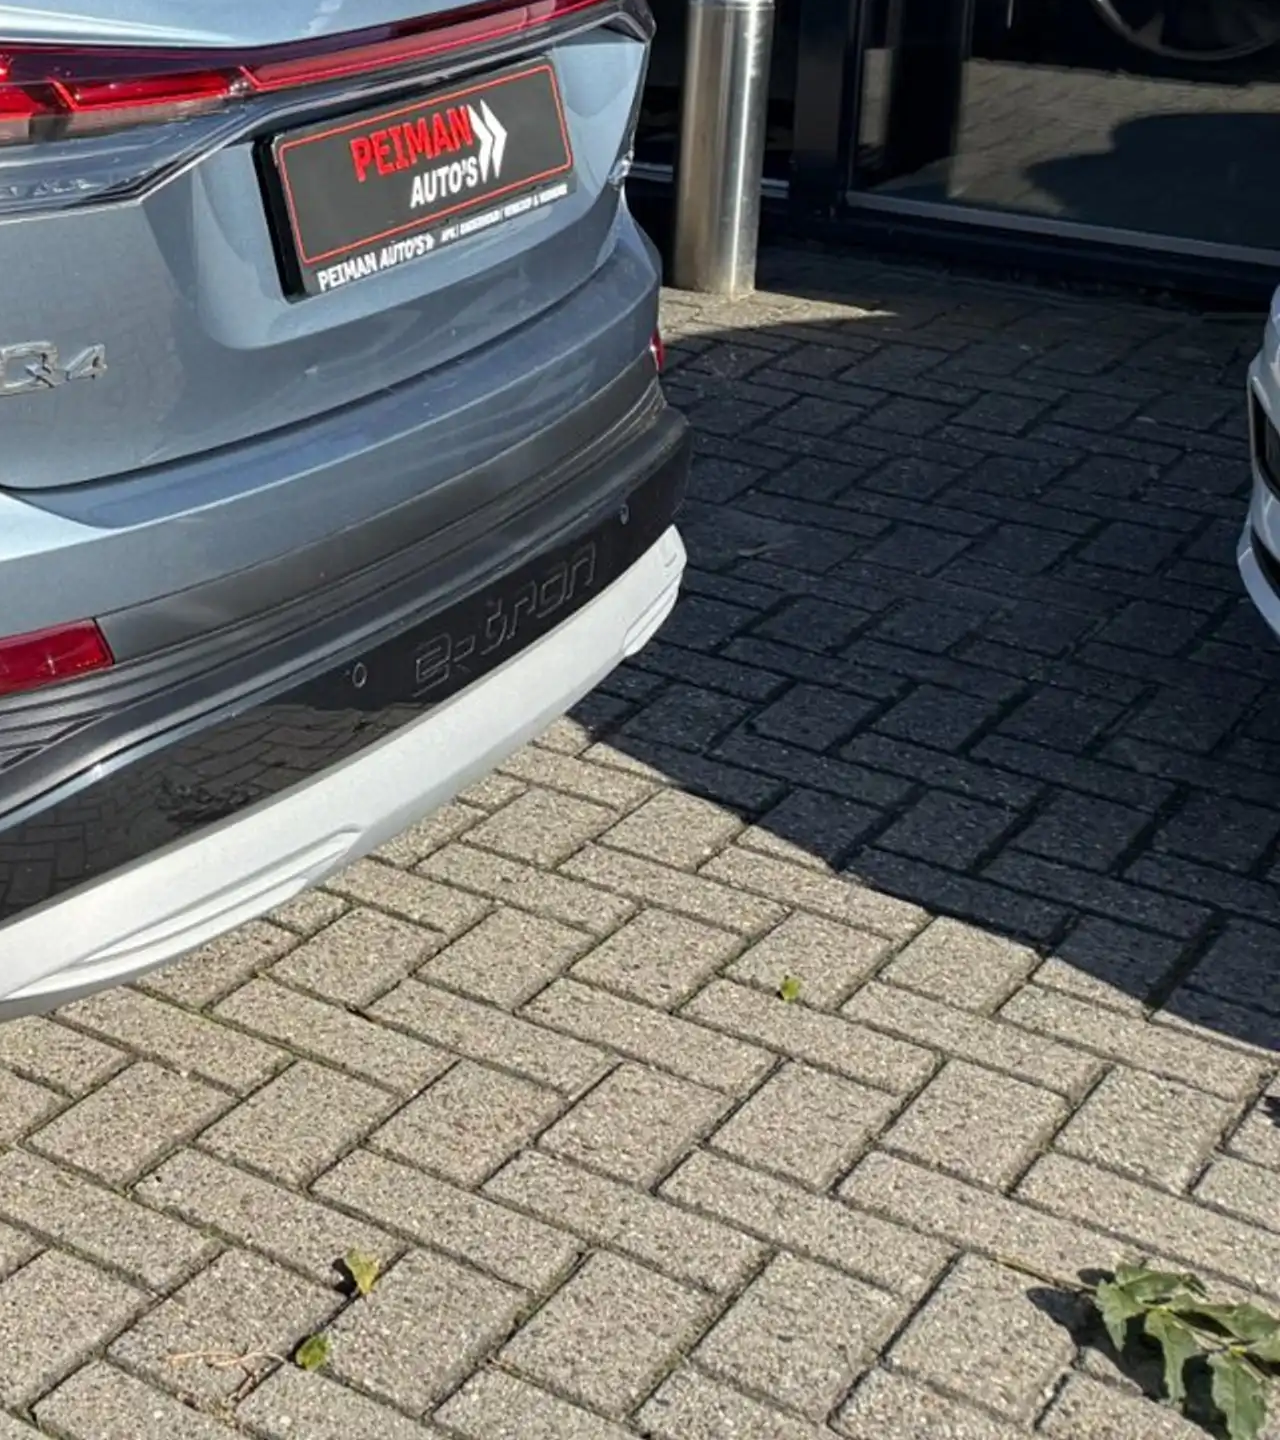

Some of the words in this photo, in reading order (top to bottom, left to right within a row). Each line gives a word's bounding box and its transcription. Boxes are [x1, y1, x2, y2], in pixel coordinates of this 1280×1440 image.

[350, 105, 473, 182] PEIMAN
[410, 156, 478, 209] AUTO'S
[317, 252, 378, 292] PEIMAN
[379, 233, 425, 268] AUTO'S
[413, 541, 596, 697] e-tron
